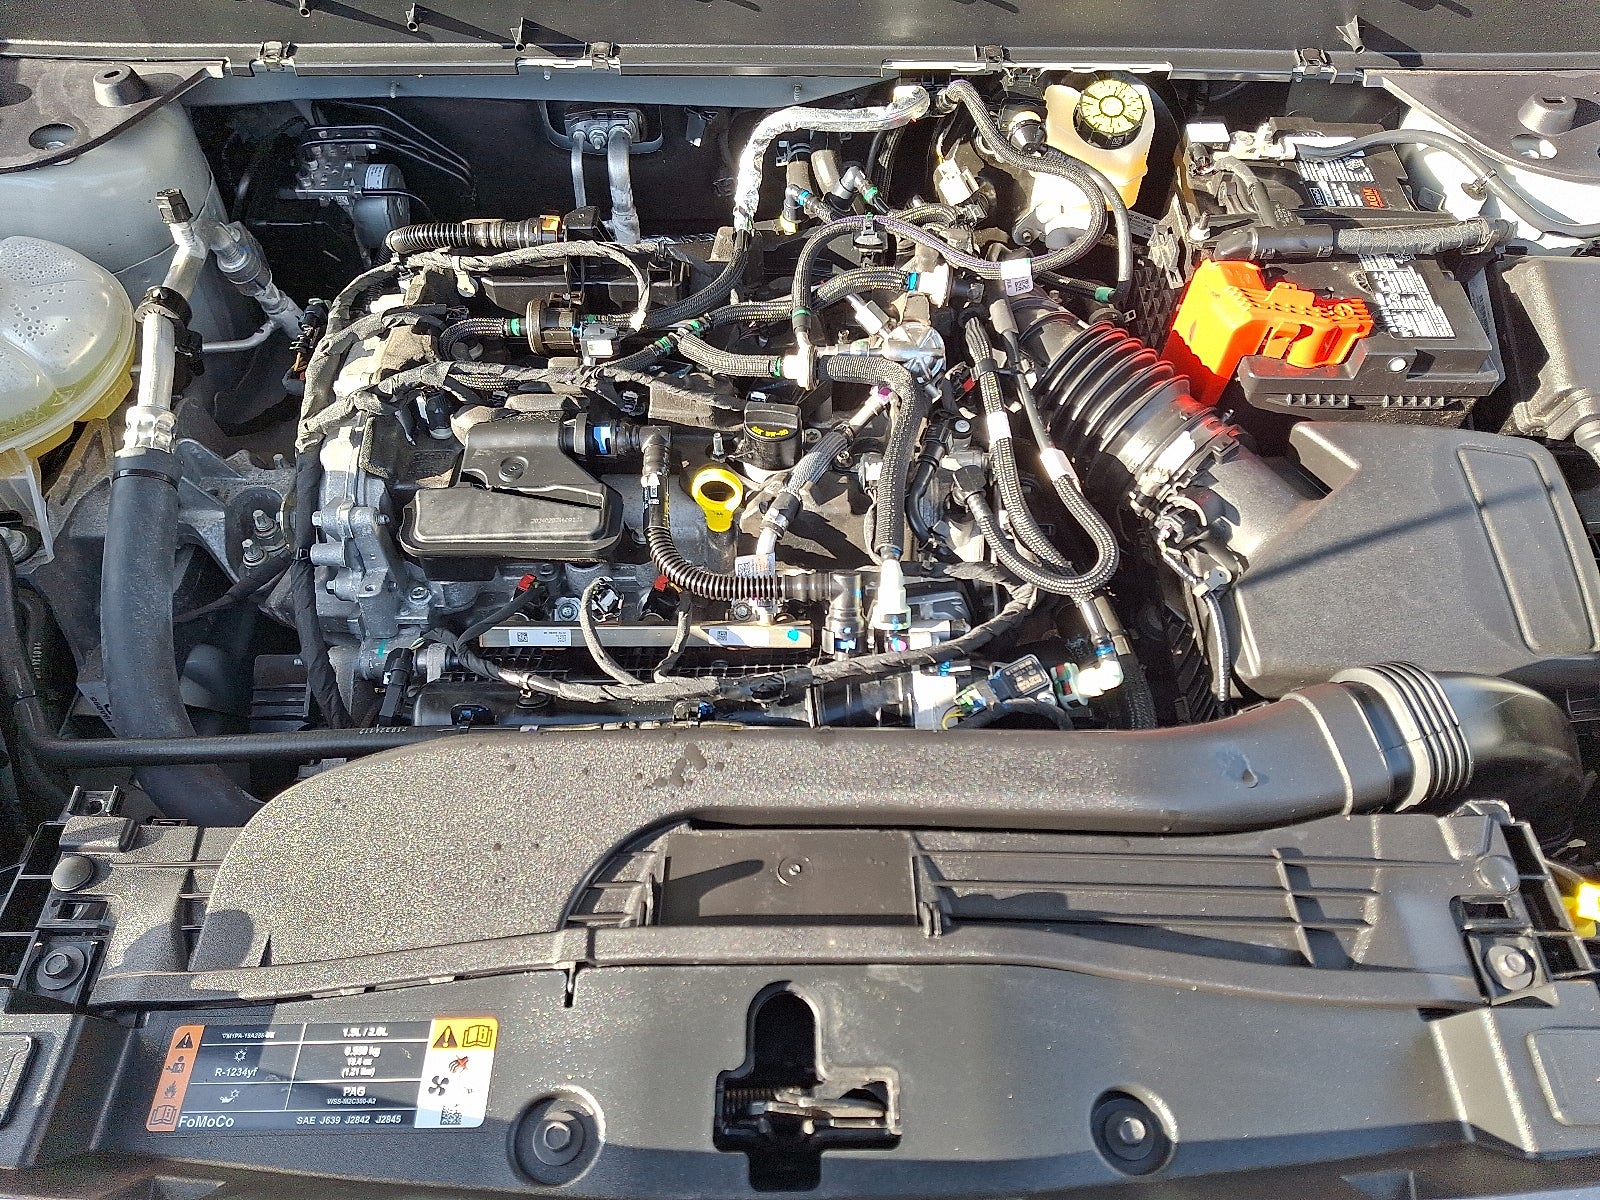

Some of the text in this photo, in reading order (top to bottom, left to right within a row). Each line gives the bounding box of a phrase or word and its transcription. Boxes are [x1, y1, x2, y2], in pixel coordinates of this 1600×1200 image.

[215, 1067, 259, 1078] R-1234yf
[343, 1086, 366, 1097] PAG
[178, 1115, 235, 1128] FoMoCo
[296, 1114, 402, 1125] SAE J639 J2842 J2845
